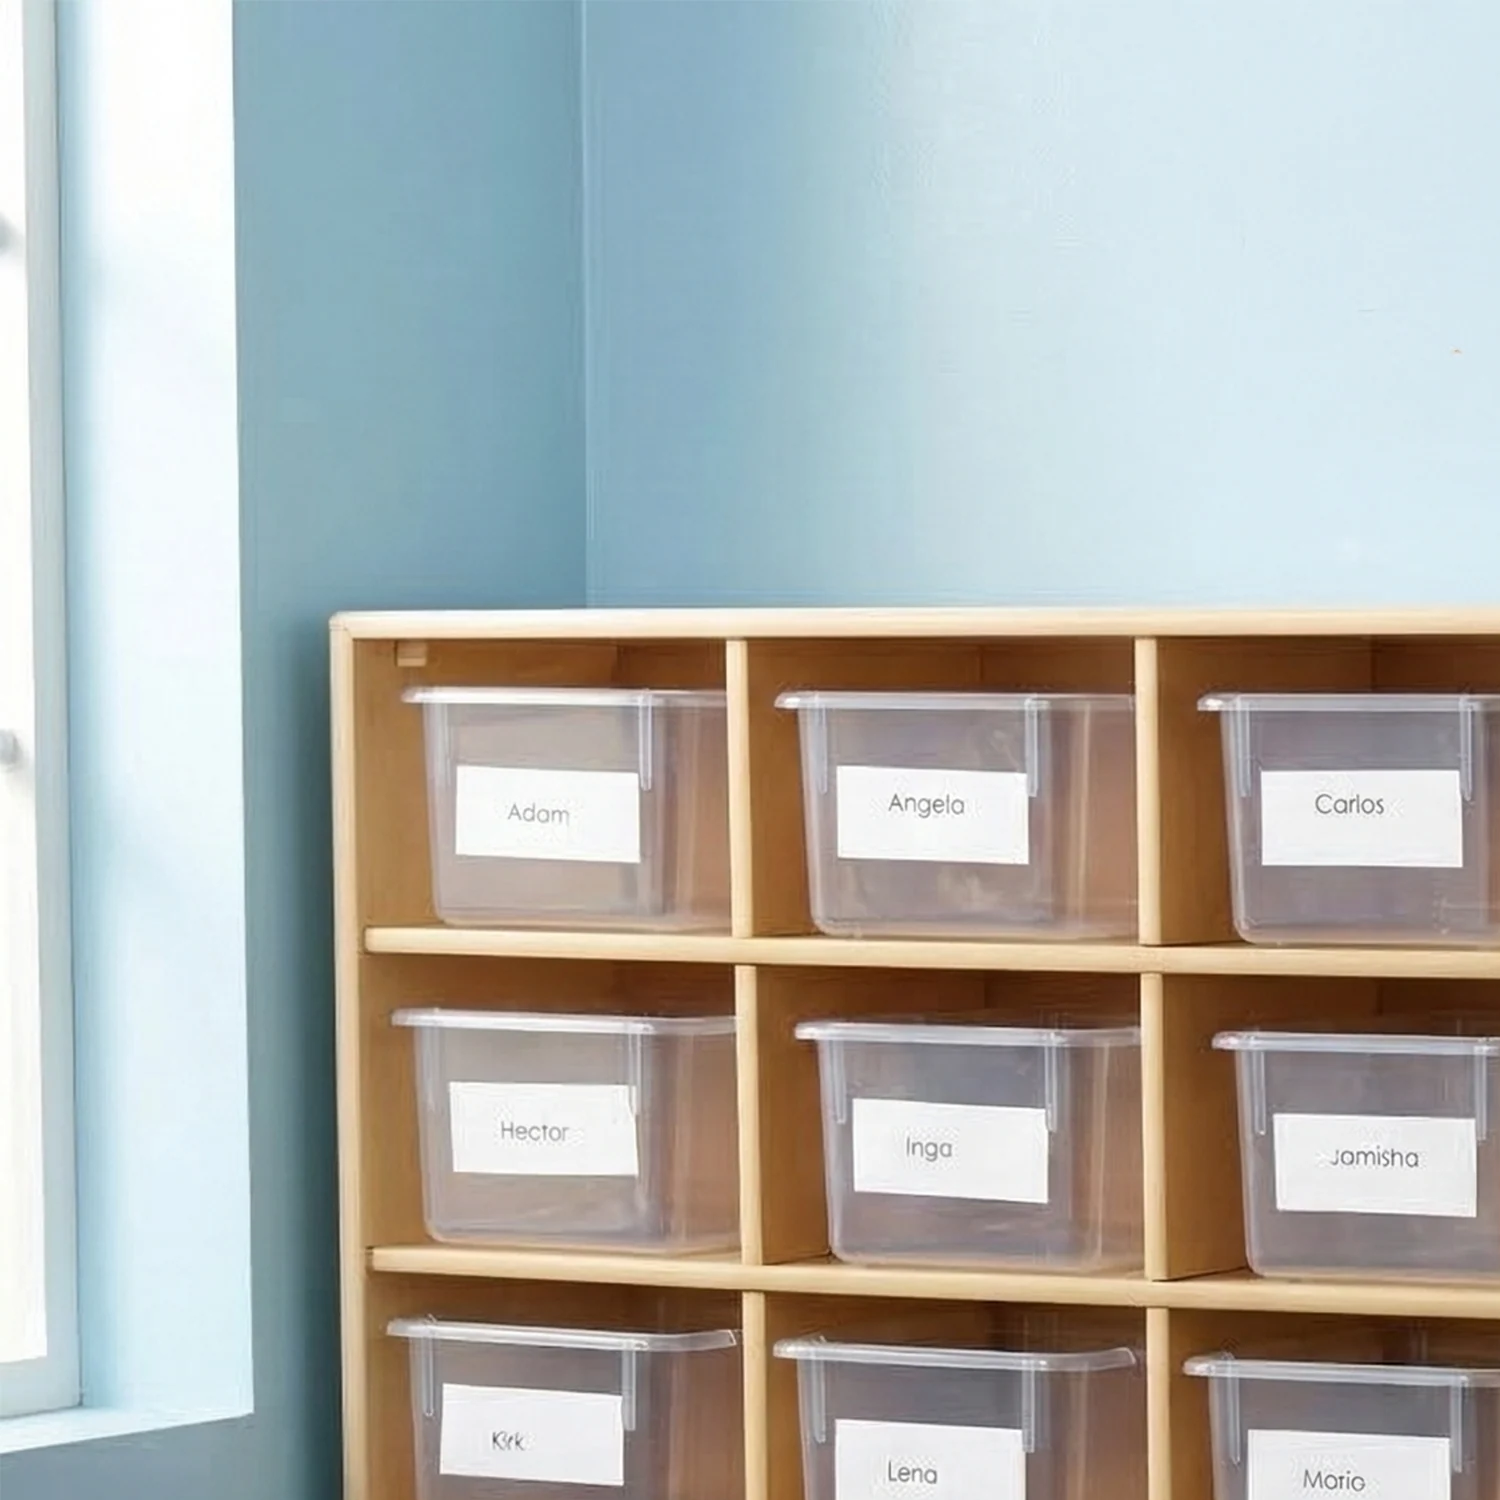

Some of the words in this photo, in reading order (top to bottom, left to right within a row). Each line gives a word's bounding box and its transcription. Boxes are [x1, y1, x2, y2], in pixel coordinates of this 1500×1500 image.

[507, 803, 570, 824] Adam
[888, 793, 965, 819] Angela
[1314, 793, 1385, 816] Carlos
[501, 1121, 569, 1142] Hector
[906, 1136, 953, 1163] Inga
[887, 1460, 938, 1485] Lena
